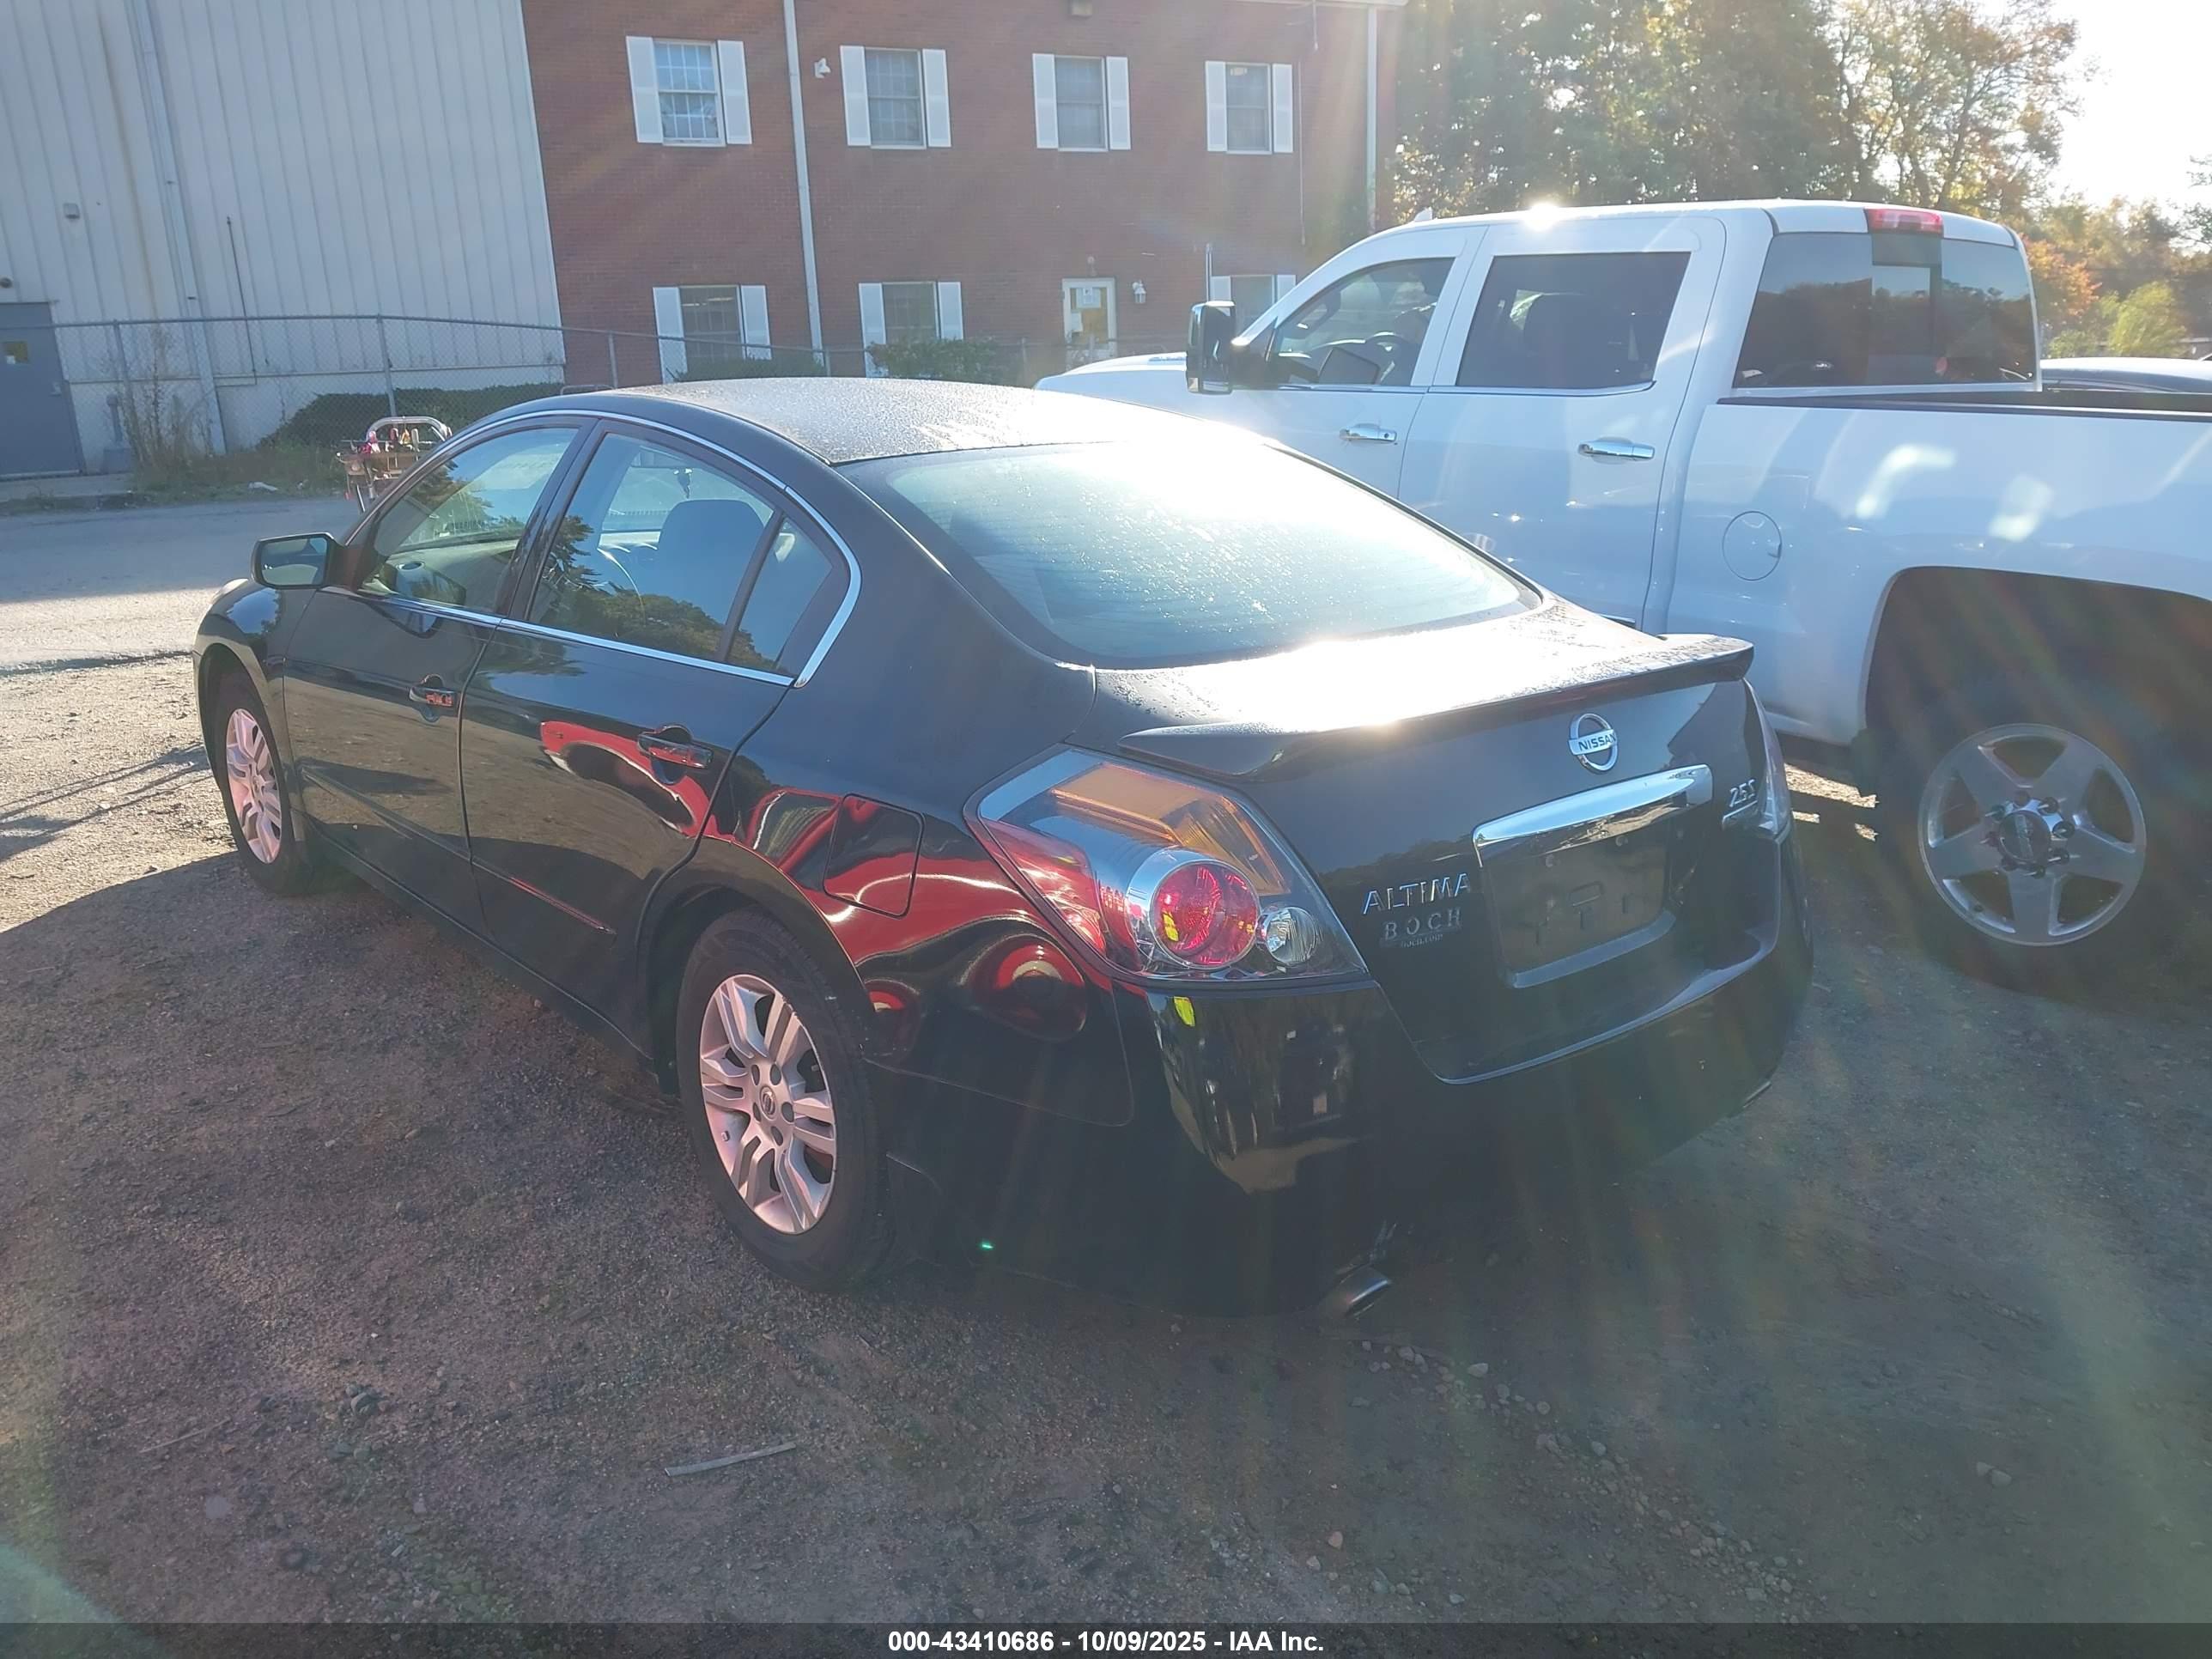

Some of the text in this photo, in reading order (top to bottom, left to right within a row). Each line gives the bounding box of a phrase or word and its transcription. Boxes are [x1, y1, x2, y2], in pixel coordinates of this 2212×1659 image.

[1578, 733, 1616, 751] NISSAN
[1362, 872, 1470, 915] ALTIMA
[1384, 907, 1462, 940] BOCH
